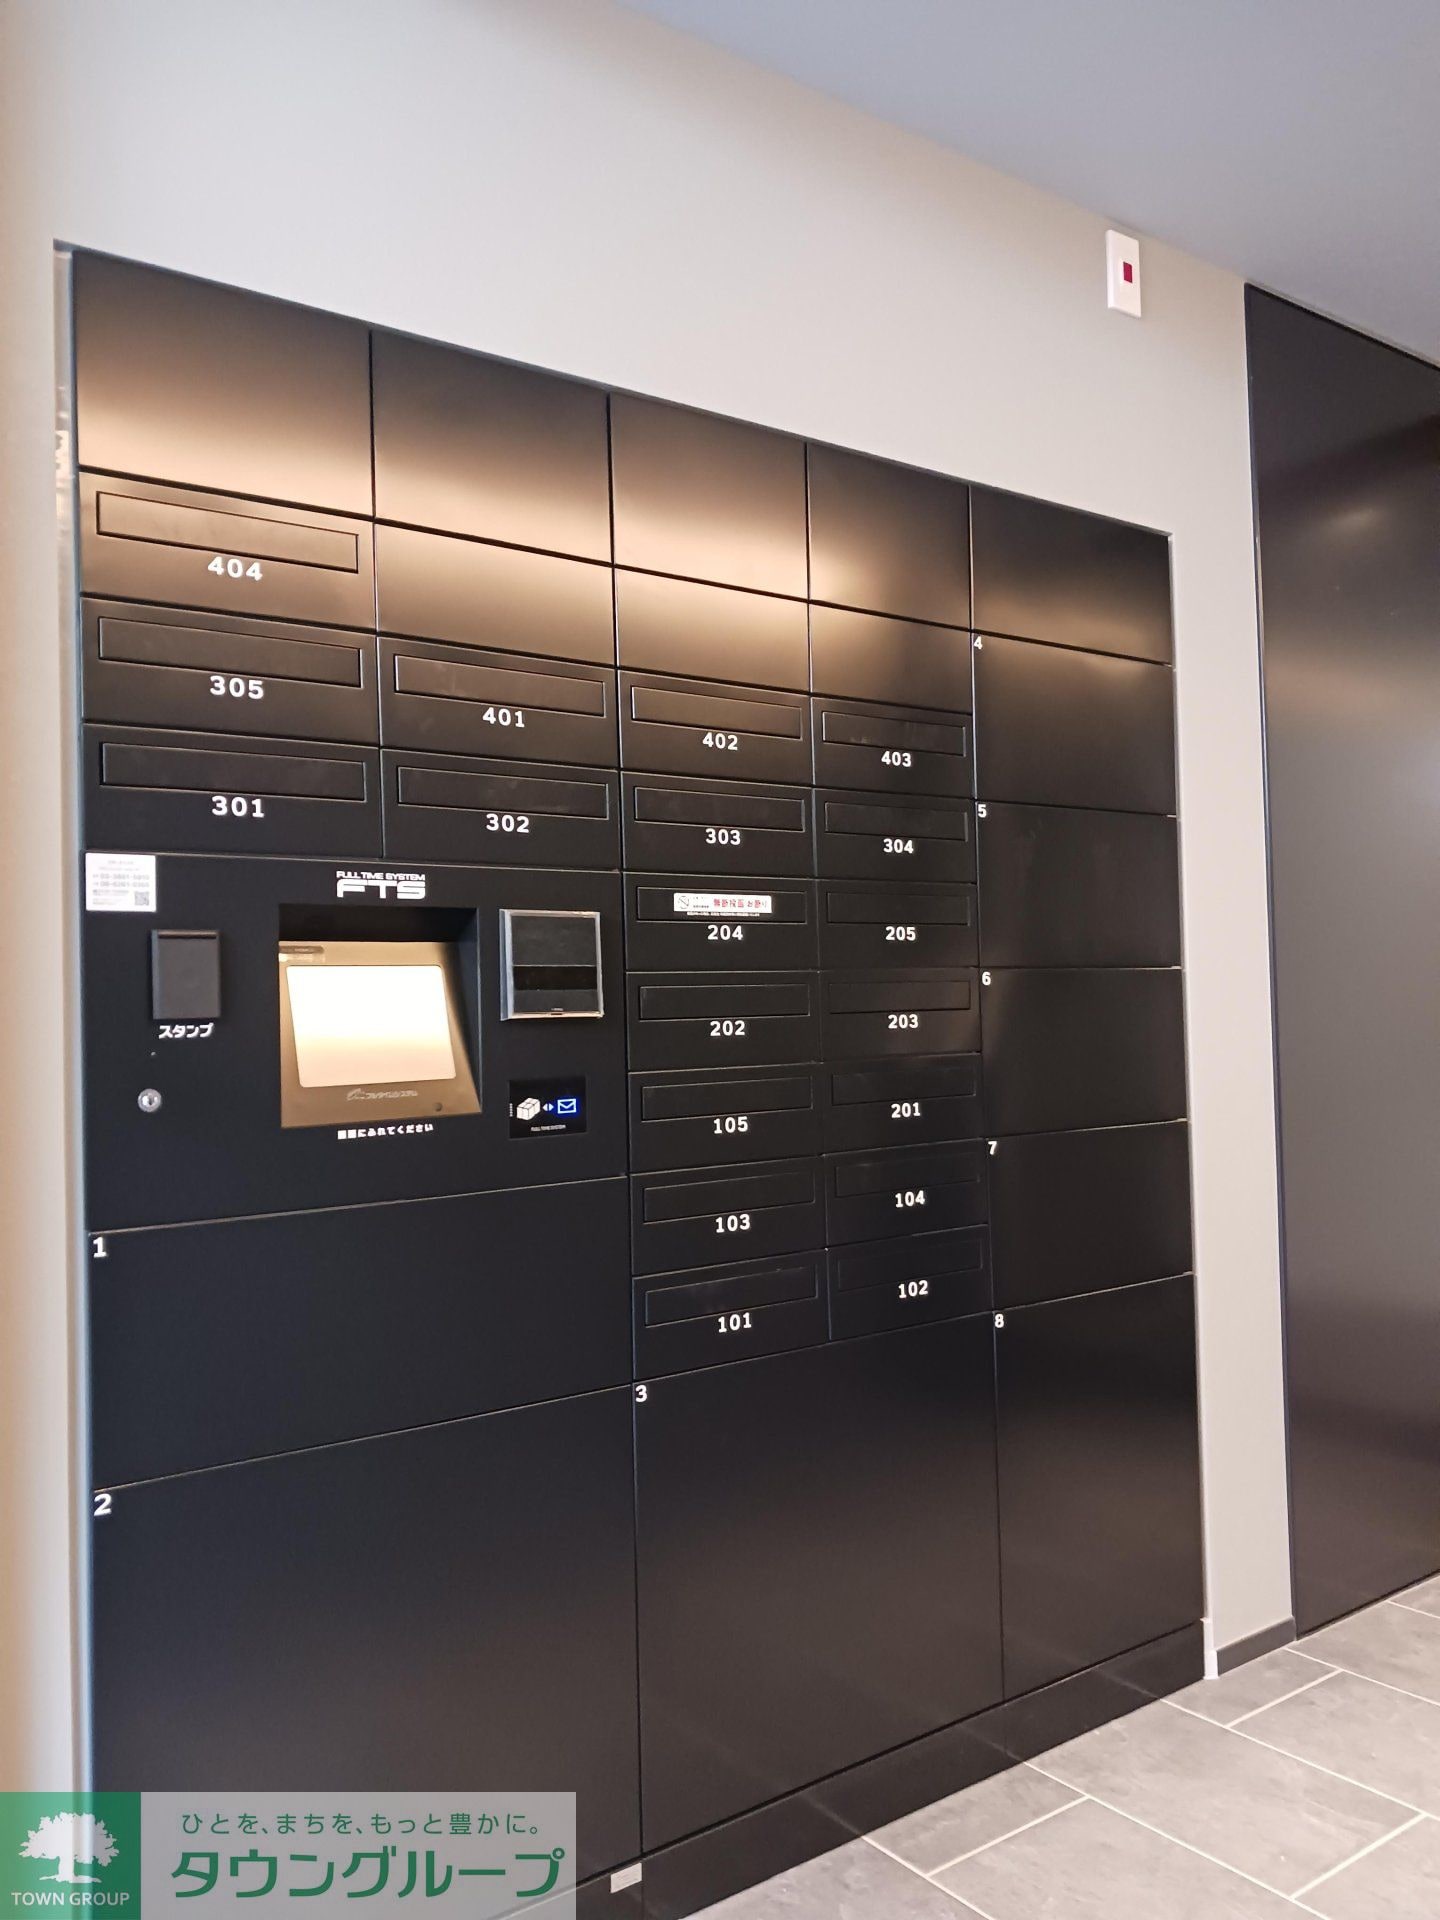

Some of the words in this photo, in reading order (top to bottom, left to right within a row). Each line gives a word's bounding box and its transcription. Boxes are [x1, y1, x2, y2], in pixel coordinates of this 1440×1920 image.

[207, 556, 263, 581] 404
[973, 635, 983, 650] 4
[209, 675, 264, 700] 305
[482, 706, 525, 728] 401
[702, 732, 739, 751] 402
[881, 750, 912, 768] 403
[211, 795, 265, 818] 301
[977, 803, 987, 818] 5
[486, 813, 530, 834] 302
[705, 827, 743, 846] 303
[883, 838, 914, 855] 304
[336, 870, 361, 879] FULL
[361, 872, 384, 880] TIME
[385, 873, 425, 881] SYSTEM
[336, 879, 426, 900] FTS
[706, 923, 744, 941] 204
[885, 925, 916, 941] 205
[981, 971, 992, 986] 6
[158, 1022, 214, 1040] スタンプ
[710, 1019, 746, 1038] 202
[887, 1013, 919, 1030] 203
[890, 1102, 921, 1119] 201
[713, 1115, 749, 1135] 105
[987, 1140, 998, 1155] 7
[895, 1190, 926, 1208] 104
[714, 1213, 751, 1234] 103
[92, 1236, 107, 1259] 1
[897, 1279, 929, 1299] 102
[717, 1312, 752, 1333] 101
[994, 1313, 1005, 1329] 8
[635, 1384, 648, 1403] 3
[93, 1493, 112, 1517] 2
